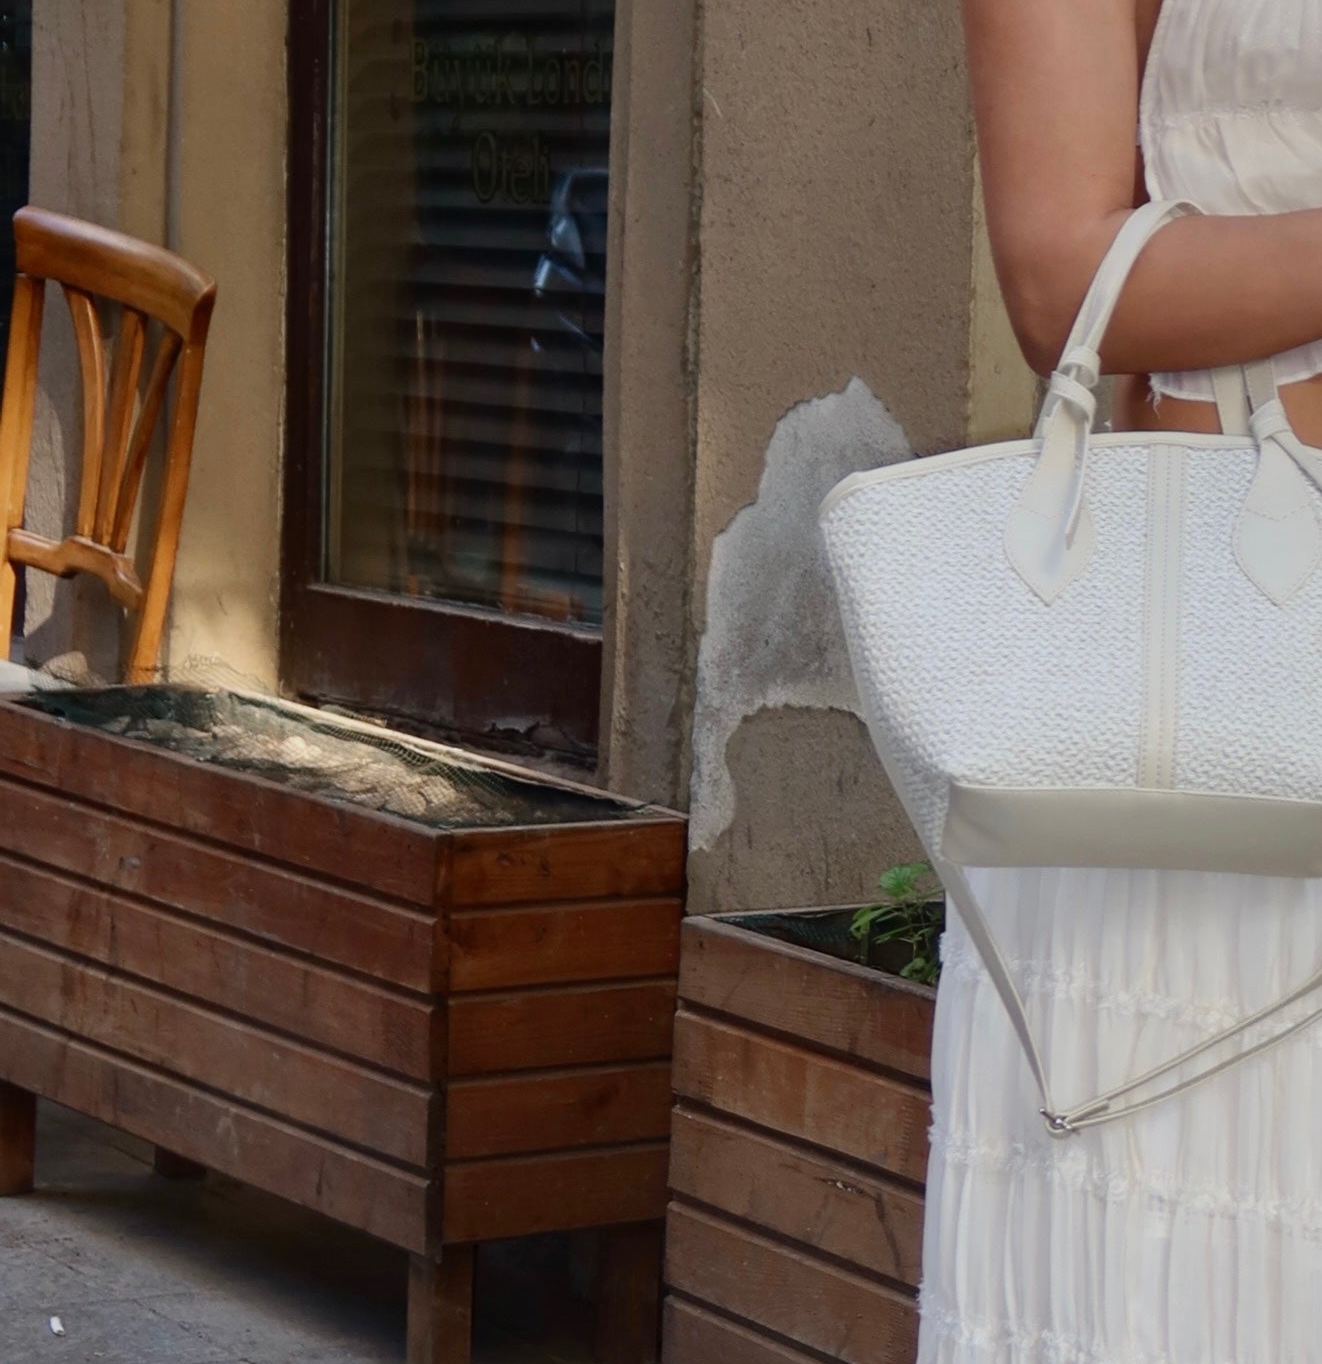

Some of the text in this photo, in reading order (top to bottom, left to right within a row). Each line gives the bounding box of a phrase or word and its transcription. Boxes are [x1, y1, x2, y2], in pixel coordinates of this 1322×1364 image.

[410, 33, 613, 132] Büyük Lond
[471, 130, 552, 204] Oteli
